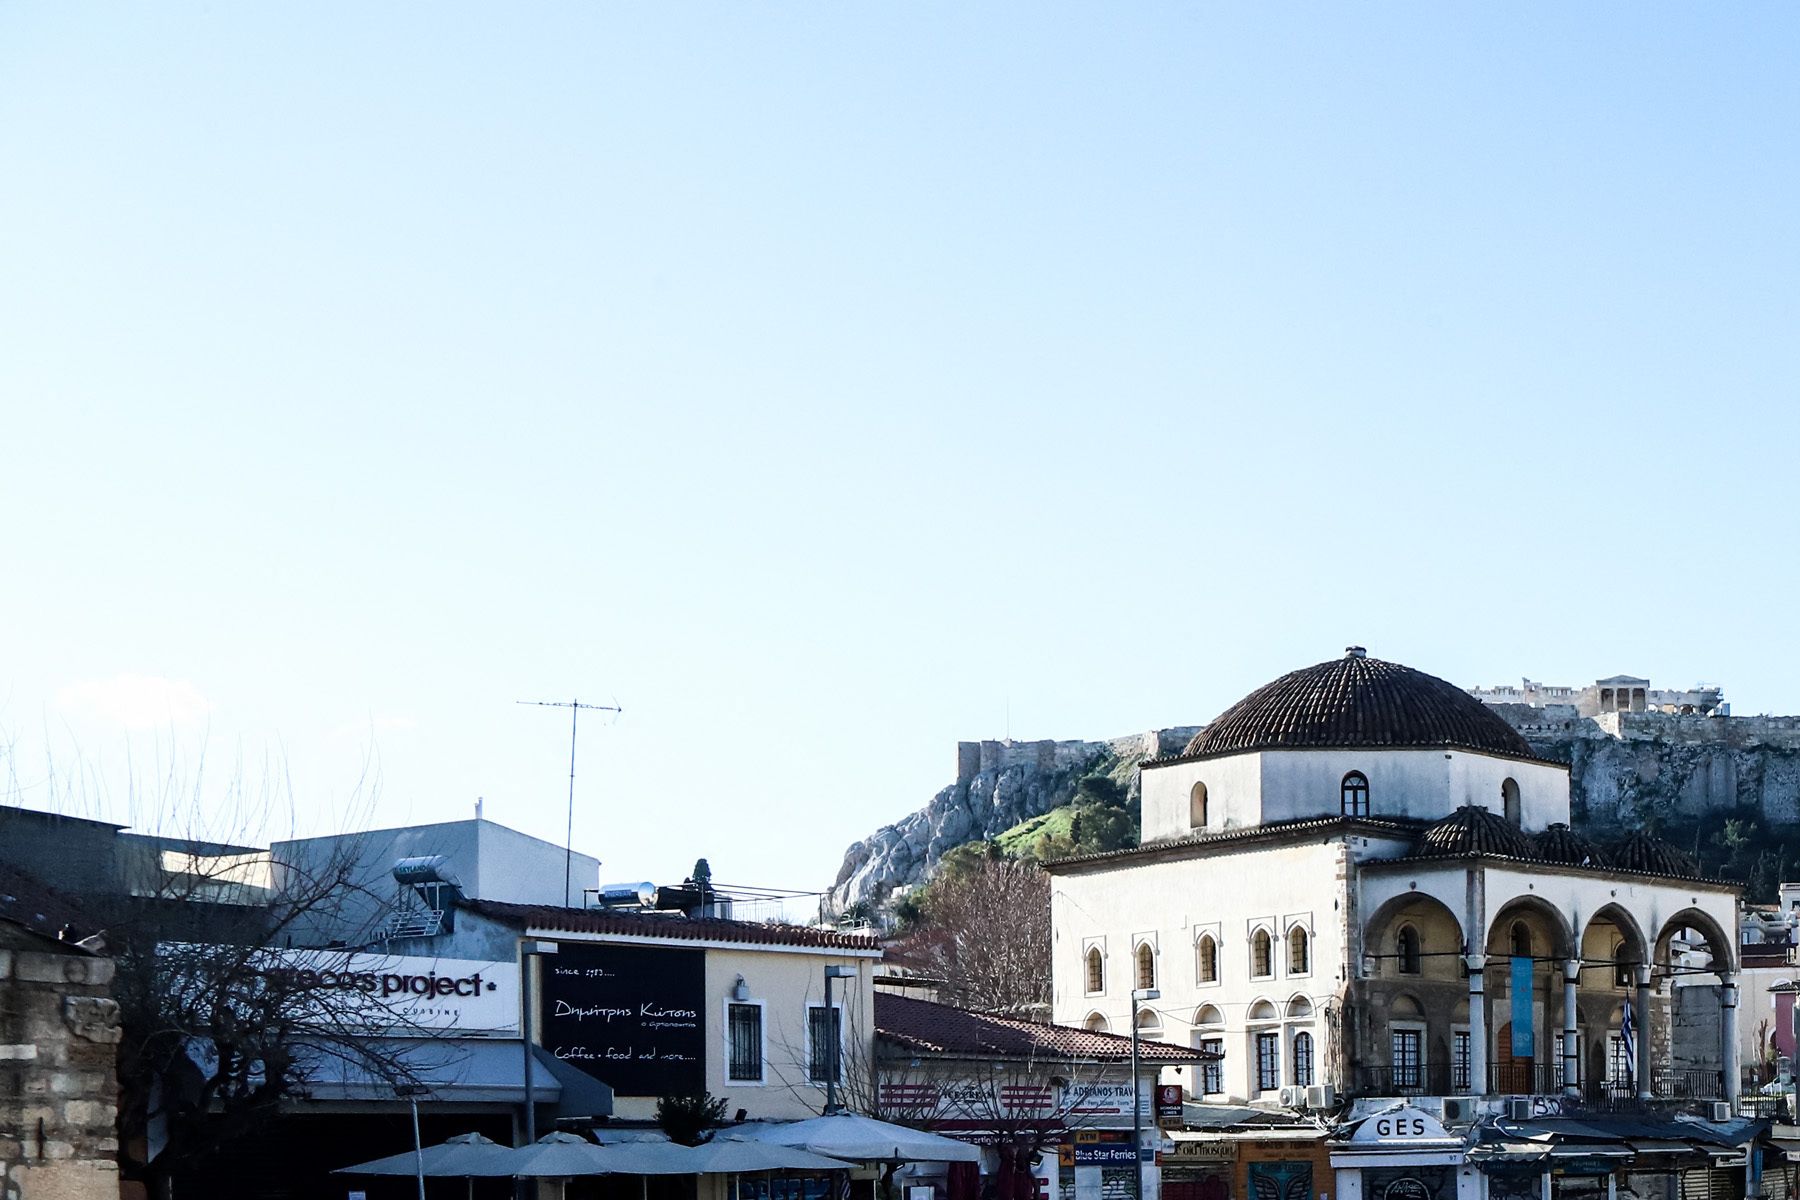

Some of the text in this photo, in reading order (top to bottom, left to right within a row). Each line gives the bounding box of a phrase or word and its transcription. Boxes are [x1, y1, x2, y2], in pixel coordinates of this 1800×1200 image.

[555, 967, 580, 975] since
[383, 971, 482, 999] project
[554, 1046, 595, 1060] Coffee
[605, 1046, 632, 1060] food
[638, 1048, 656, 1060] and
[1073, 1086, 1135, 1097] ADRIANOS TRAV
[1376, 1118, 1425, 1136] GES
[1075, 1149, 1093, 1160] Blue
[1094, 1149, 1109, 1160] Star
[1110, 1149, 1137, 1160] Ferries
